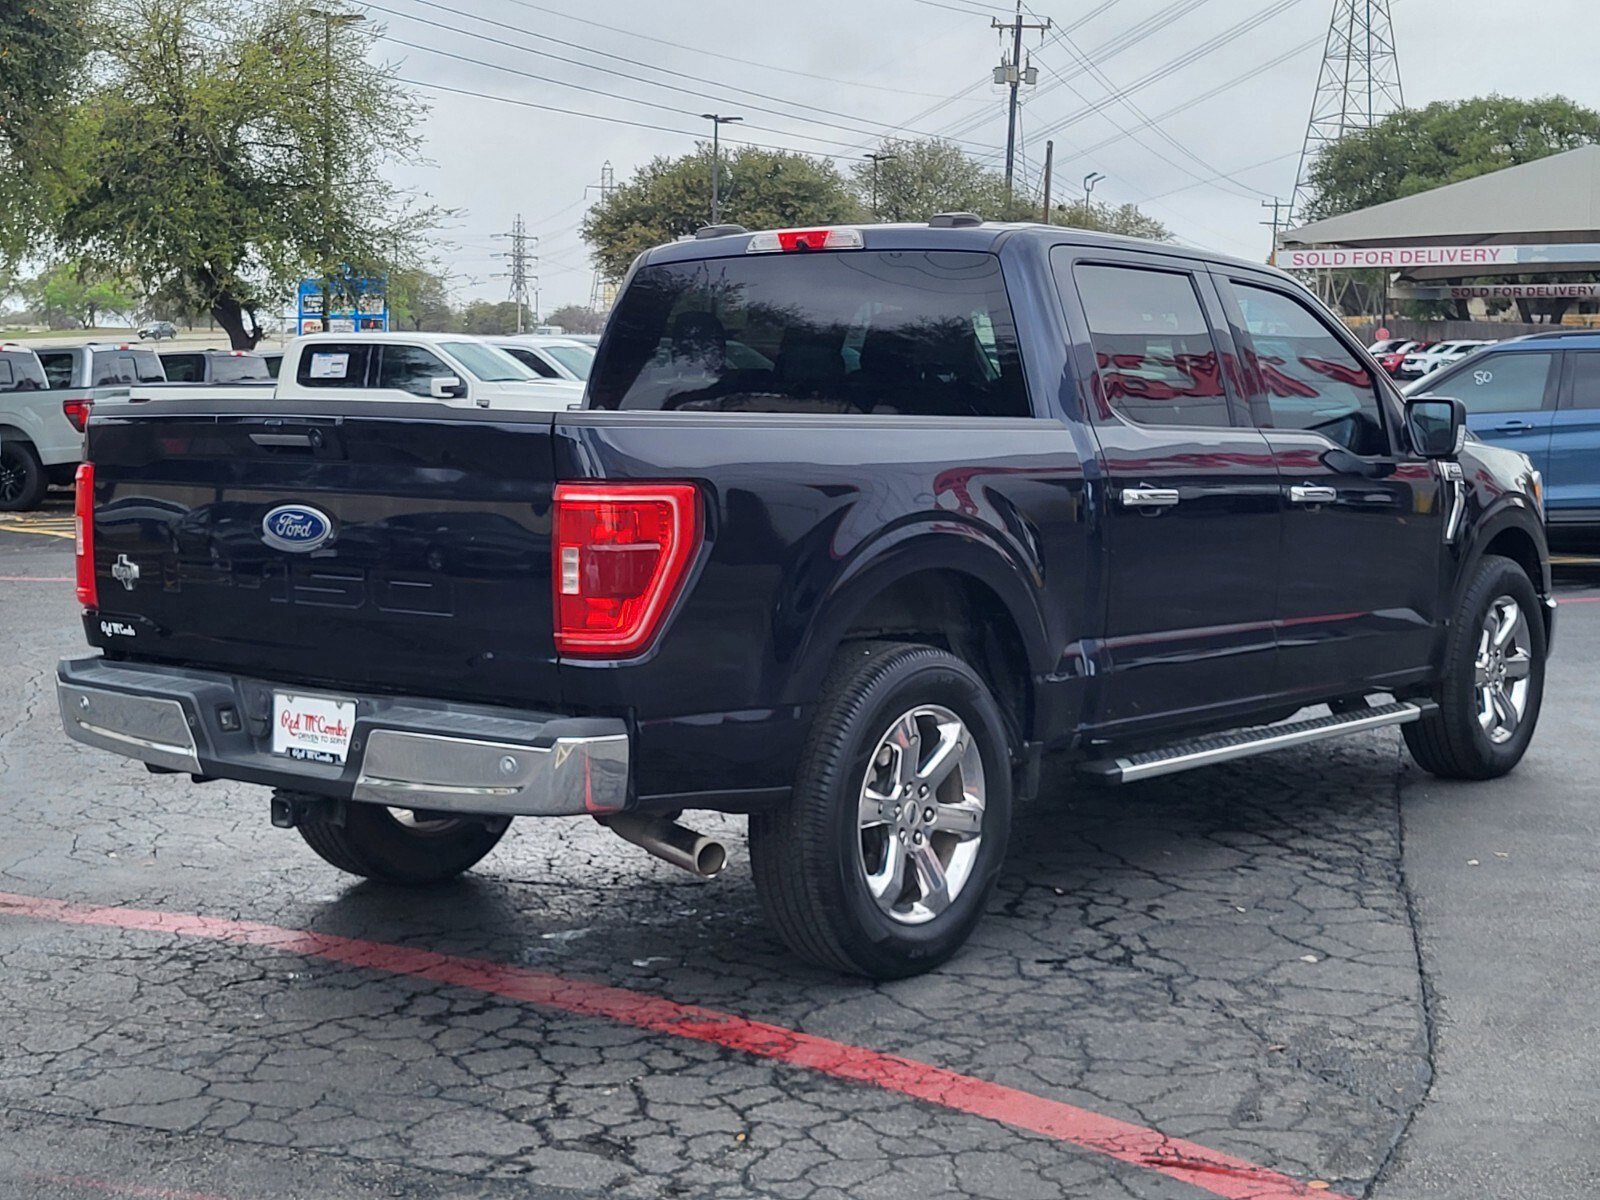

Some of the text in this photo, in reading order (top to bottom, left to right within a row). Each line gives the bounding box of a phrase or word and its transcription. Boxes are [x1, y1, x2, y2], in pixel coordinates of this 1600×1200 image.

[1293, 249, 1500, 266] SOLD FOR DELIVERY
[1451, 285, 1597, 298] SOLD FOR DELIVERY
[1473, 370, 1493, 385] 80
[276, 512, 313, 537] Ford
[281, 709, 347, 737] Red McCombs
[298, 732, 319, 743] DRIVEN
